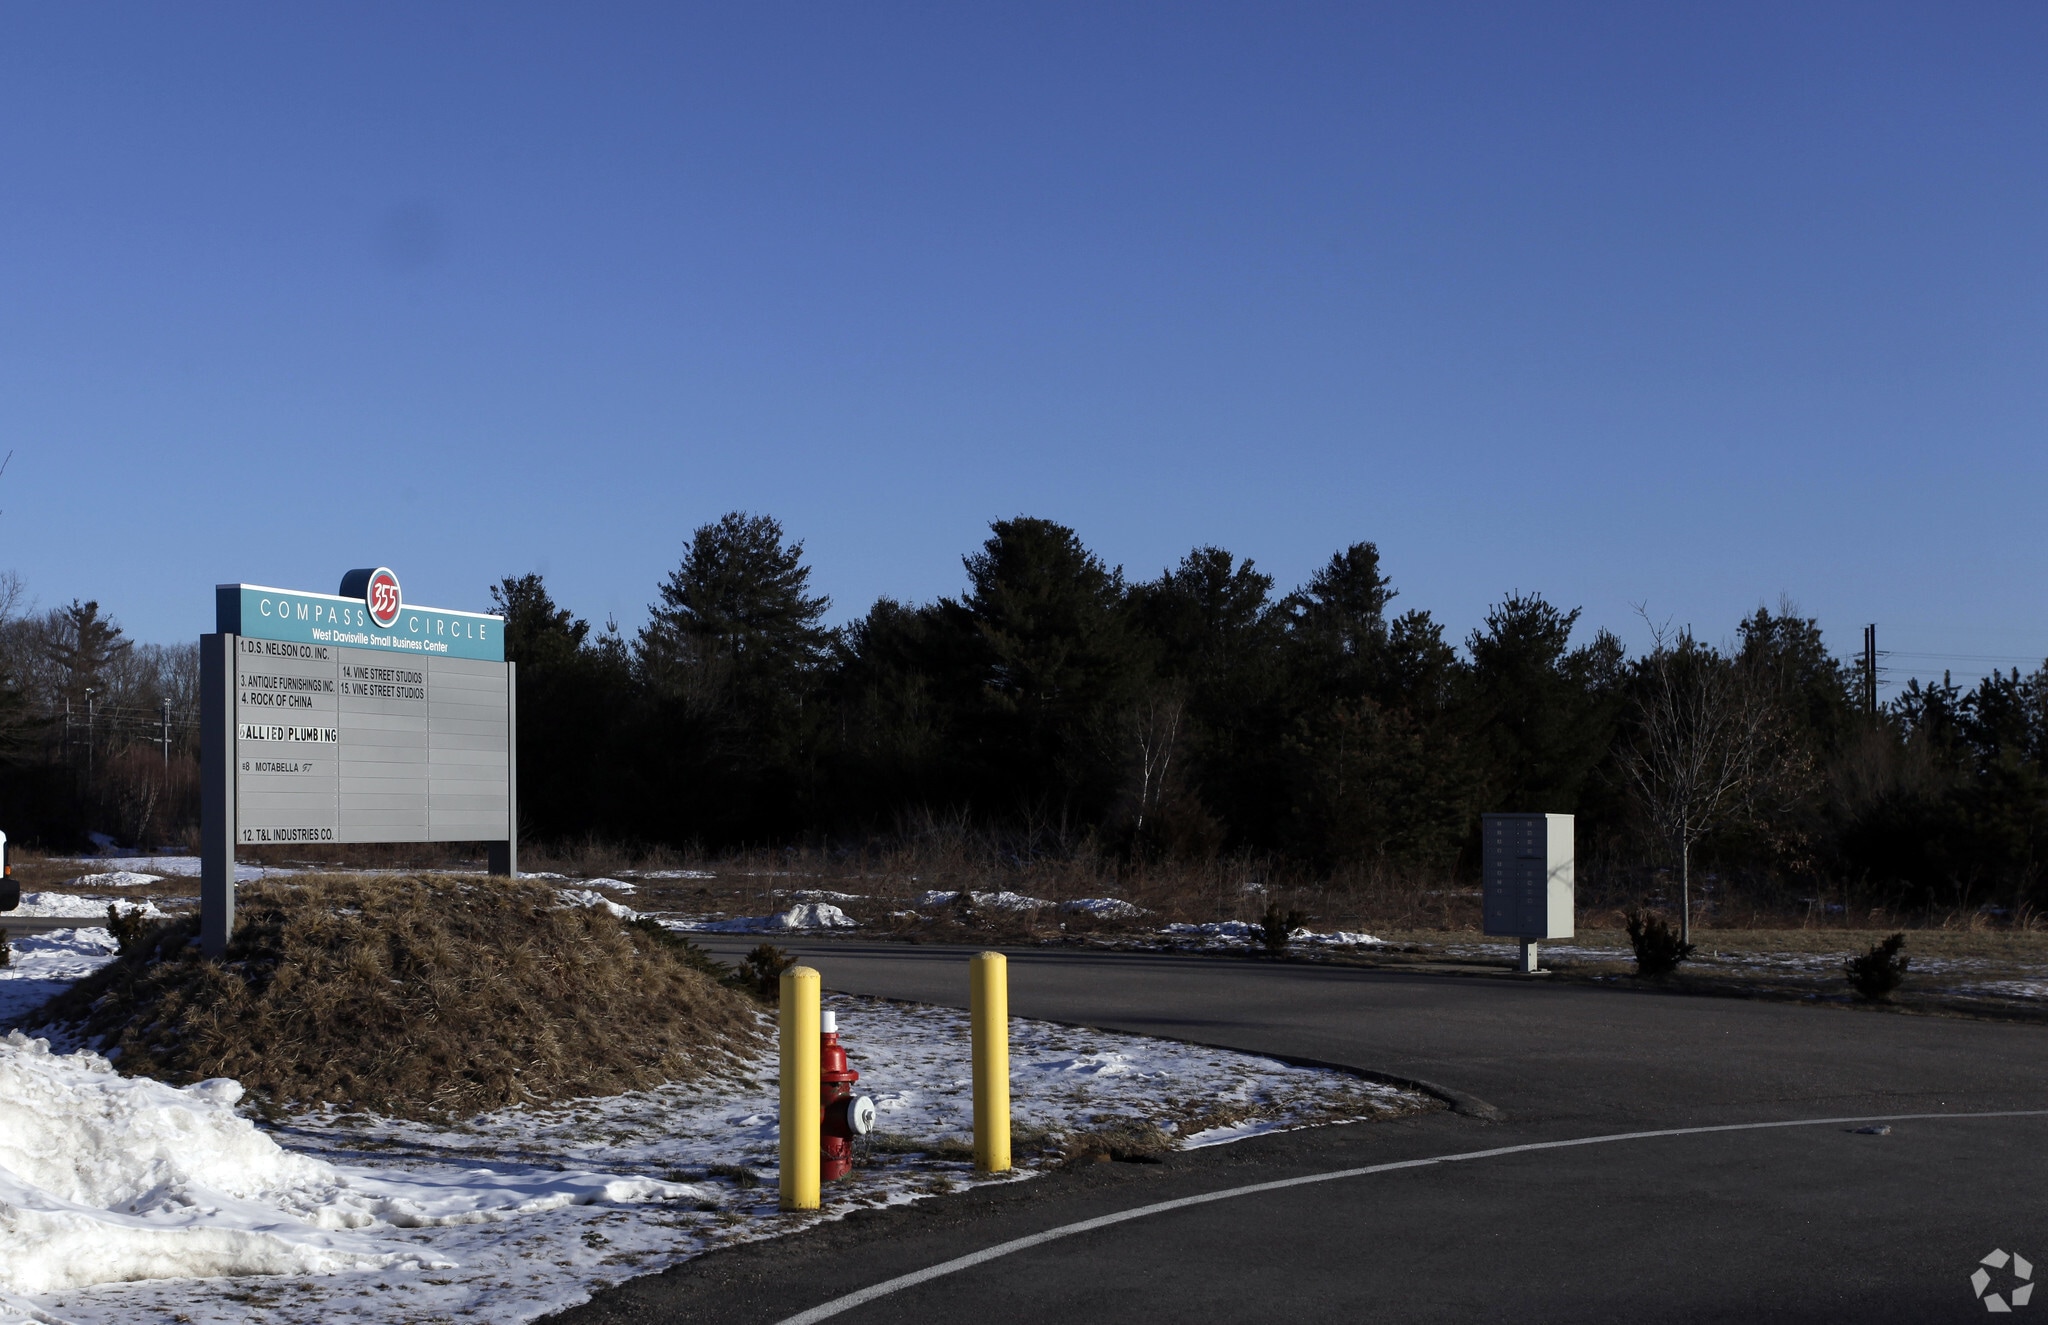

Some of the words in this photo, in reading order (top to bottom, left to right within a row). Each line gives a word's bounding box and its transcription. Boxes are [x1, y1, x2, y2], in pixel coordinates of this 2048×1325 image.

[372, 583, 399, 613] 355
[260, 599, 364, 627] COMPASS
[409, 616, 486, 640] CIRCLE
[312, 628, 331, 640] West
[333, 630, 368, 645] Davisville
[370, 634, 391, 647] Small
[392, 636, 422, 650] Business
[423, 640, 448, 653] Center
[241, 641, 246, 652] 1.
[248, 641, 263, 654] D.S.
[266, 643, 298, 657] NELSON
[300, 646, 313, 658] CO.
[315, 648, 330, 660] INC.
[241, 675, 247, 687] 3.
[248, 676, 277, 689] ANTIQUE
[279, 677, 322, 692] FURNISHINGS
[323, 681, 335, 692] INC.
[343, 666, 352, 678] 14.
[353, 666, 368, 679] VINE
[370, 668, 394, 681] STREET
[396, 670, 422, 684] STUDIOS
[341, 682, 350, 694] 15.
[352, 683, 368, 695] VINE
[370, 684, 395, 697] STREET
[396, 686, 424, 699] STUDIOS
[241, 692, 249, 704] 4.
[250, 692, 274, 706] ROCK
[276, 694, 287, 707] OF
[288, 695, 313, 708] CHINA
[288, 727, 337, 742] PLUMBING
[255, 762, 299, 773] MOTABELLA
[243, 829, 254, 841] 12.
[256, 829, 271, 841] T&L
[273, 828, 319, 841] INDUSTRIES
[320, 828, 334, 841] CO.
